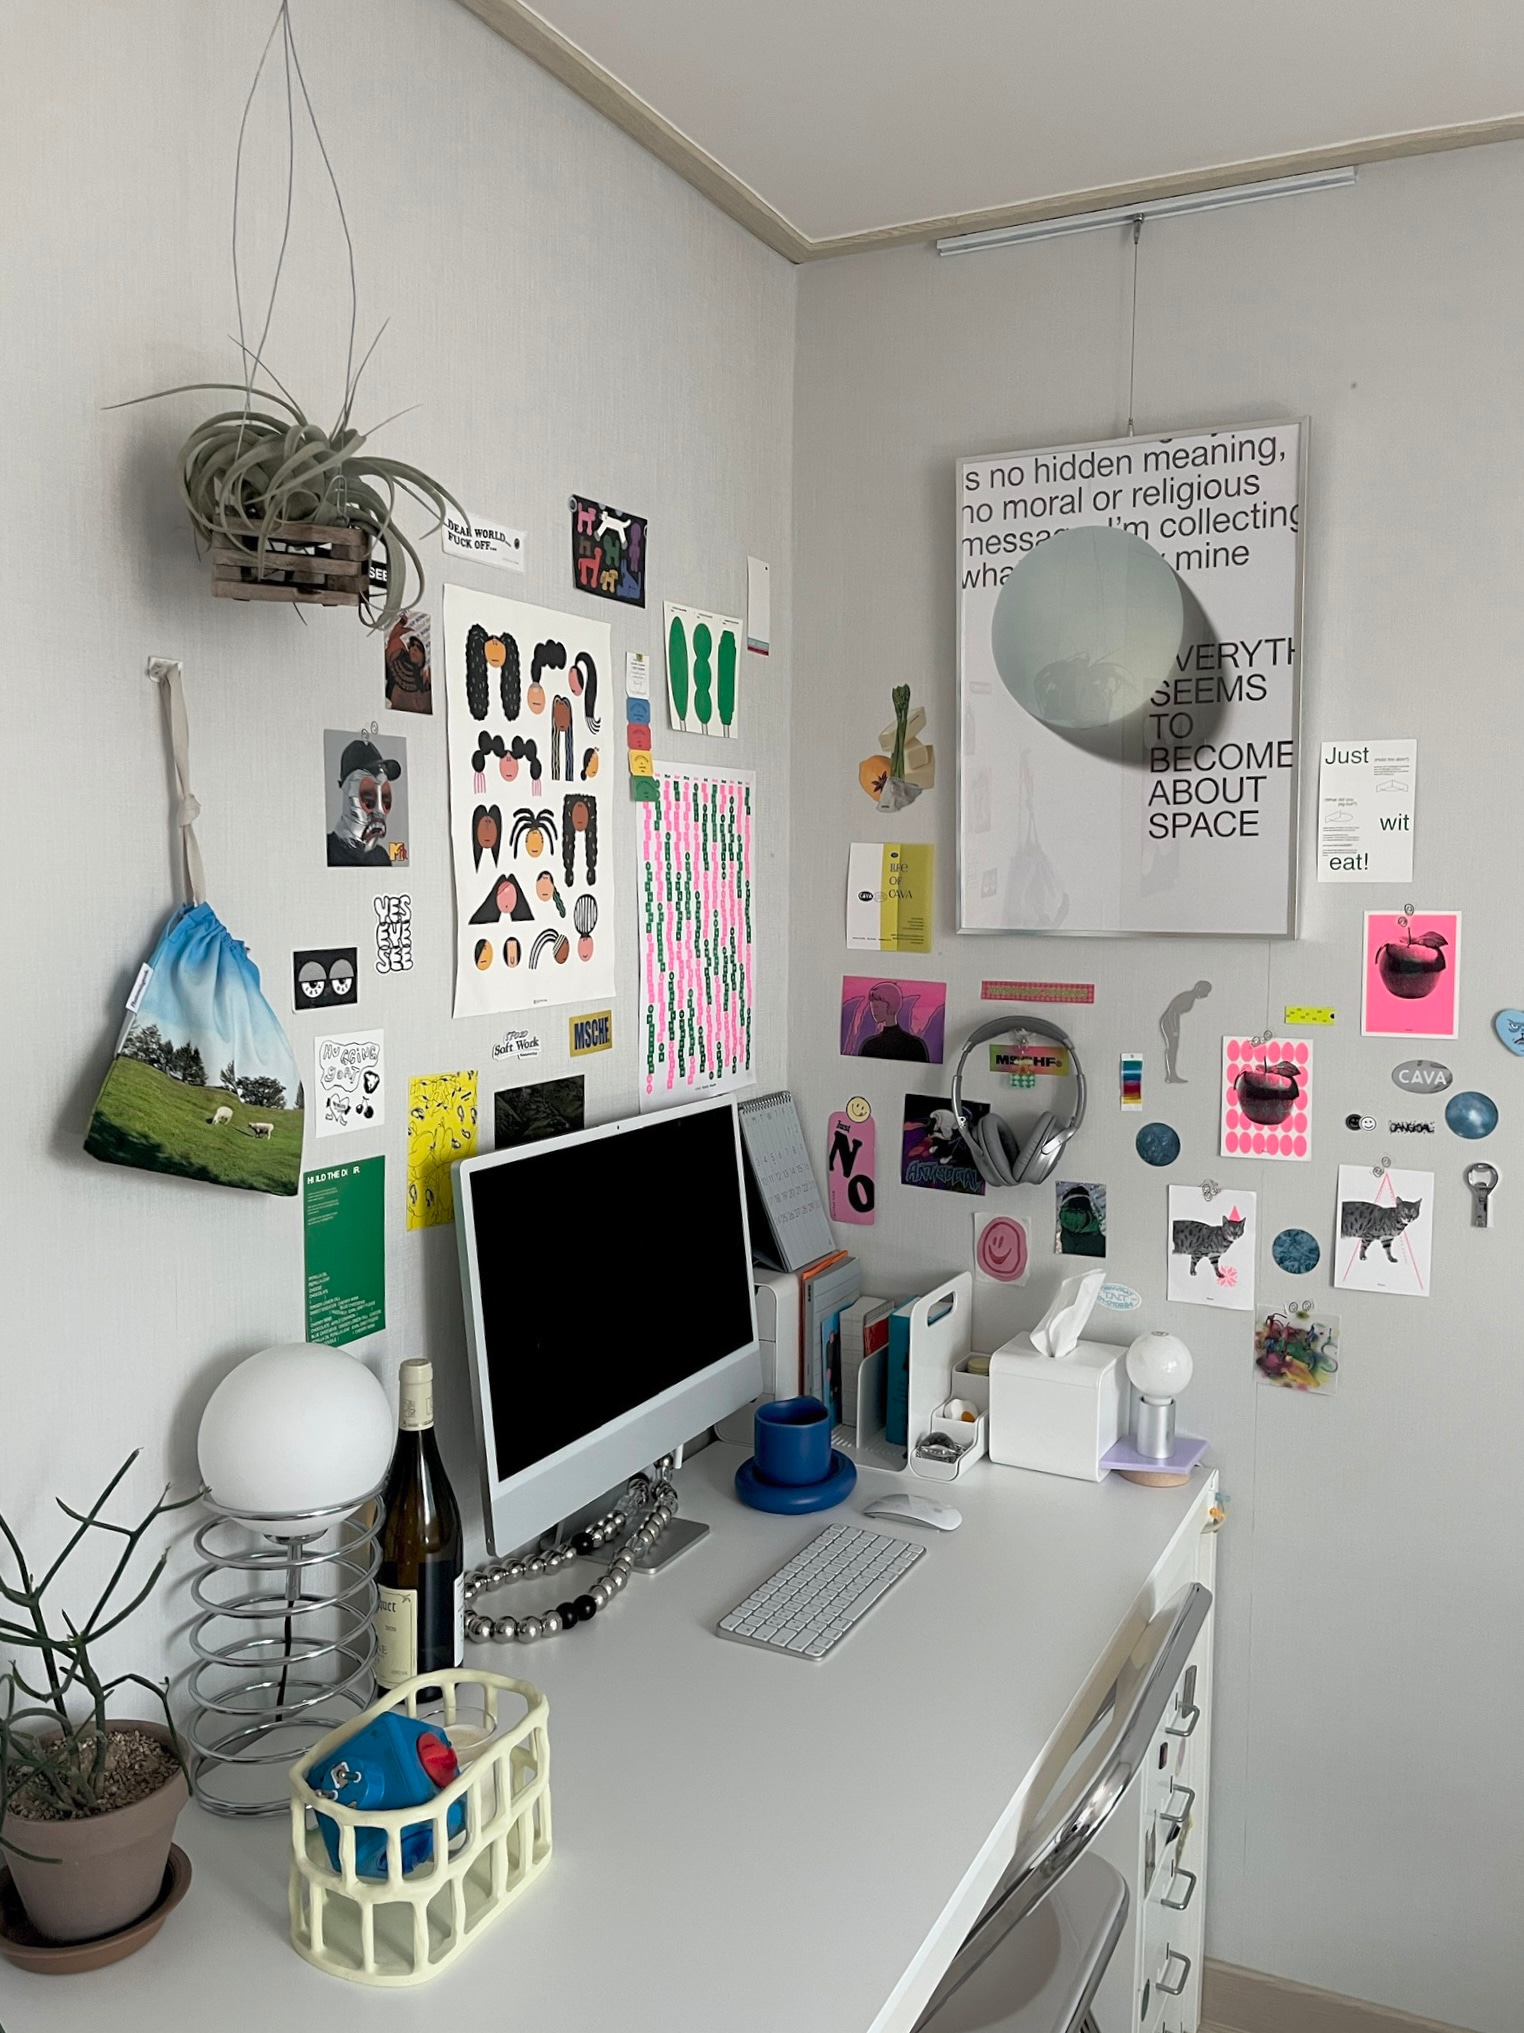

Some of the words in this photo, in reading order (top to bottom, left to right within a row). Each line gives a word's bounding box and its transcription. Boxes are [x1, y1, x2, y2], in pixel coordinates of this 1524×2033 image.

[990, 466, 1024, 489] no
[1035, 452, 1132, 484] hidden
[1143, 434, 1286, 473] meaning,
[1003, 487, 1083, 521] moral
[1093, 488, 1121, 511] or
[1132, 474, 1260, 510] religious
[447, 518, 473, 537] DEAR
[447, 530, 473, 549] FUCK
[1176, 542, 1250, 571] mine
[1150, 673, 1267, 707] SEEMS
[1149, 712, 1193, 739] TO
[1150, 741, 1293, 773] BECOME
[1325, 747, 1369, 765] Just
[1148, 776, 1267, 806] ABOUT
[1148, 810, 1259, 839] SPACE
[1380, 812, 1410, 831] wit
[1329, 853, 1369, 870] eat!
[373, 893, 412, 924] YES
[376, 946, 414, 974] SEE
[494, 1042, 513, 1056] Soft
[516, 1036, 540, 1051] Work
[1398, 1069, 1447, 1085] CAVA
[327, 1170, 340, 1180] THE
